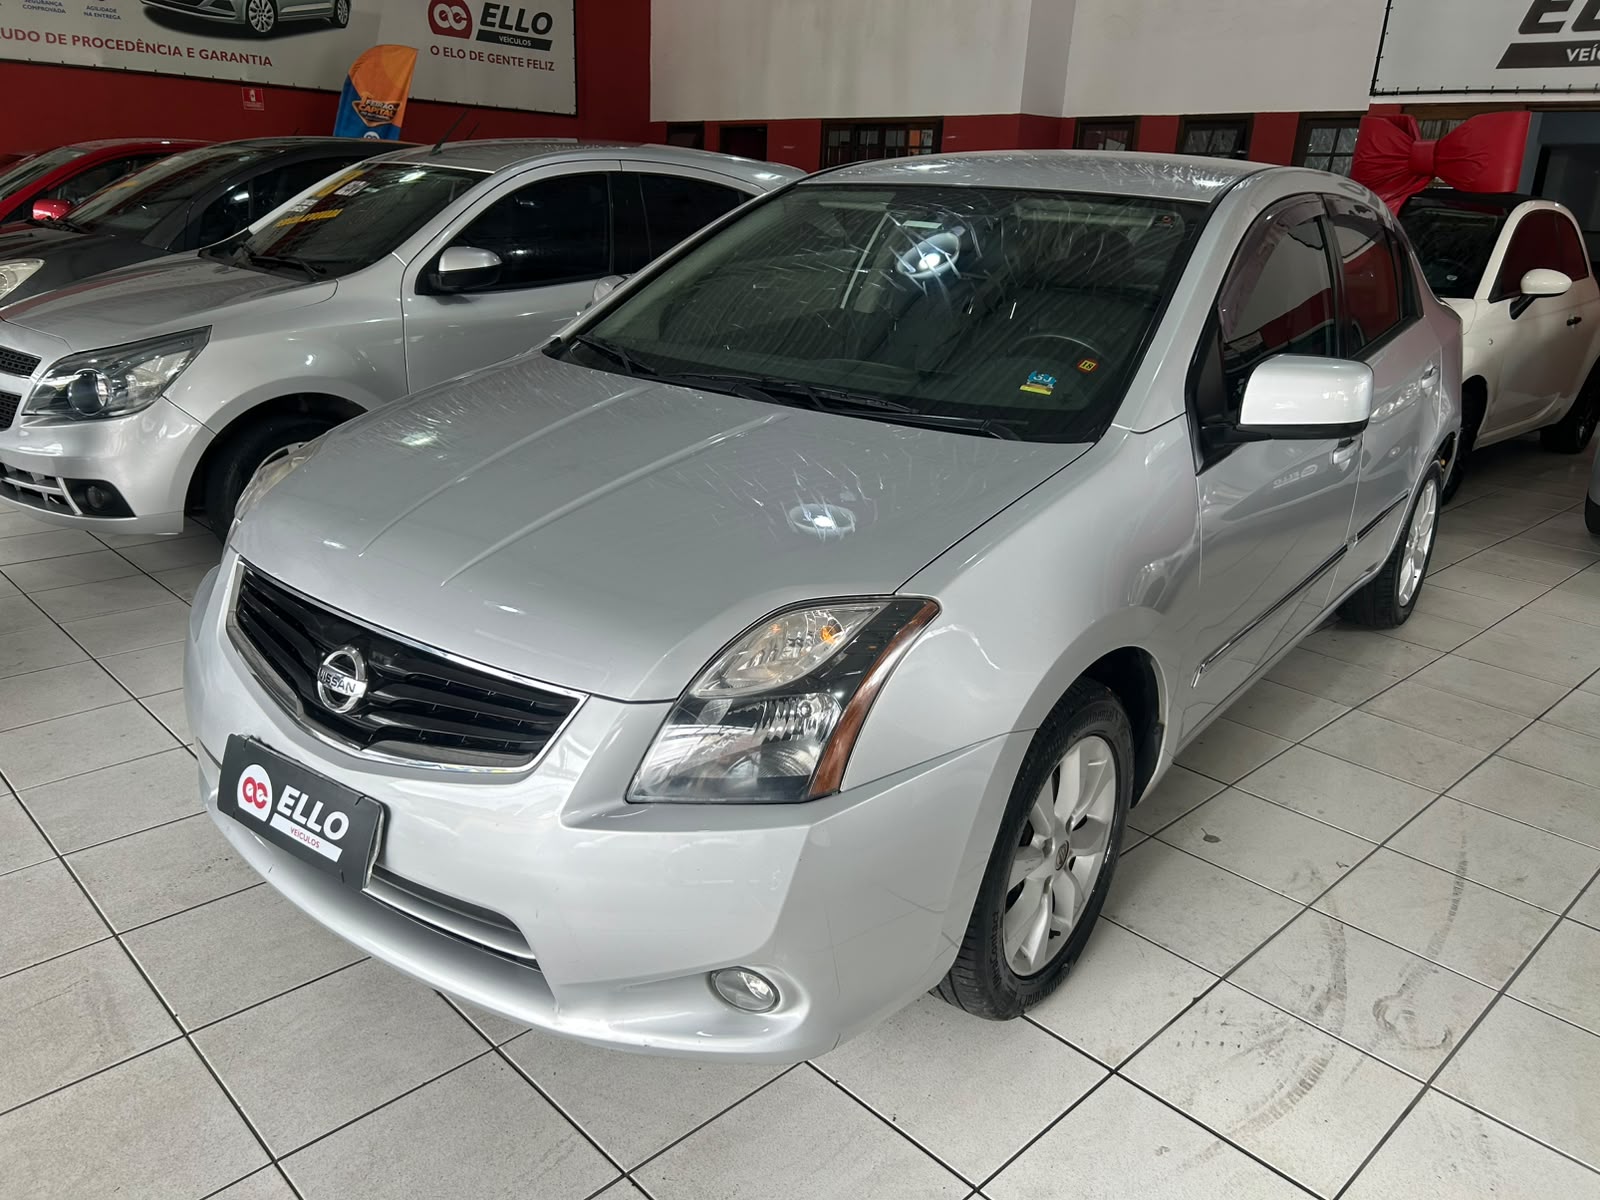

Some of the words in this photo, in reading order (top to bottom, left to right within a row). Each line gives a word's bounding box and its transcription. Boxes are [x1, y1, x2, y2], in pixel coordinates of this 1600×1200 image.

[22, 4, 67, 14] COMPROVADA
[86, 5, 118, 14] AGILIDADE
[94, 13, 121, 21] ENTREGA
[479, 2, 553, 35] ELLO
[0, 27, 41, 43] UDO
[45, 32, 67, 46] DE
[72, 34, 183, 58] PROCEDÊNCIA
[187, 47, 196, 59] E
[198, 49, 273, 67] GARANTIA
[498, 34, 532, 47] VEÍCULOS
[430, 45, 440, 56] O
[443, 47, 466, 59] ELO
[469, 50, 485, 62] DE
[487, 53, 525, 68] GENTE
[526, 58, 555, 72] FELIZ
[318, 667, 356, 693] NISSAN
[276, 785, 350, 841] ELLO
